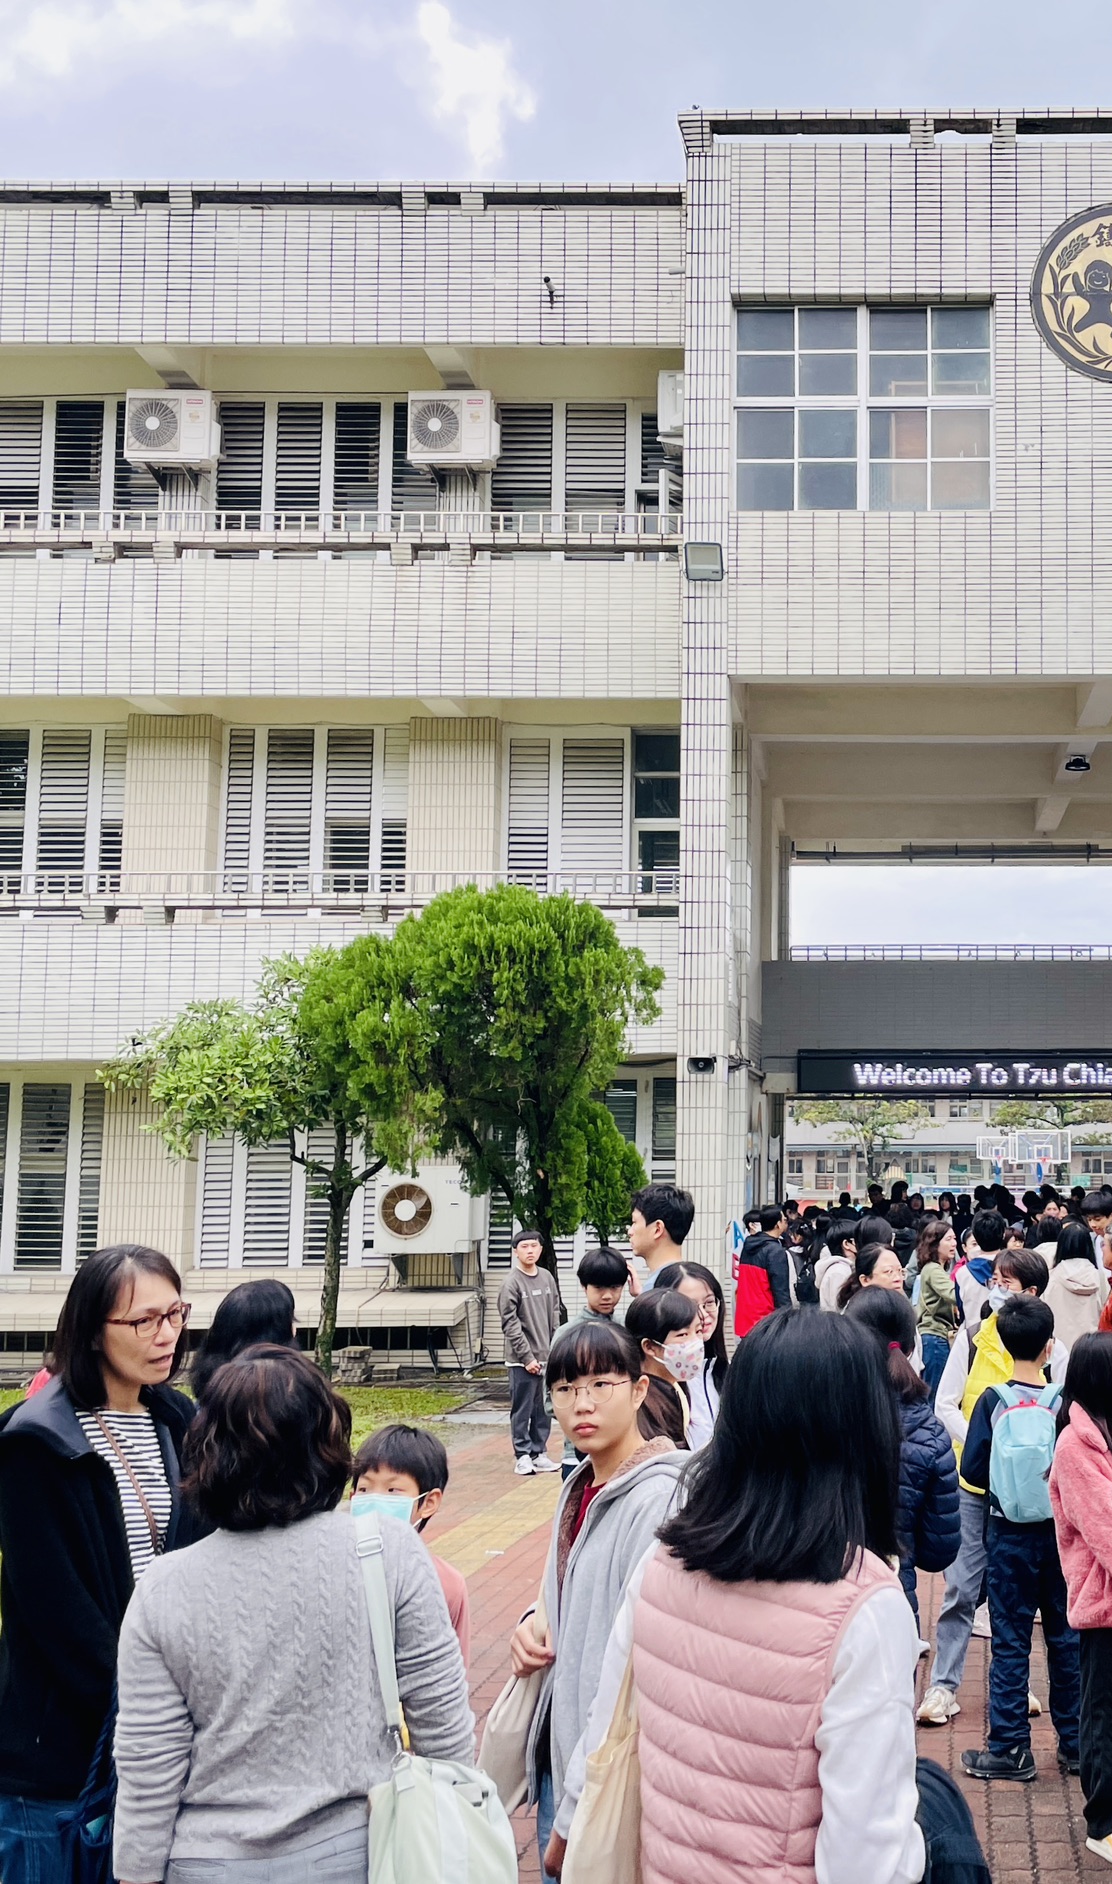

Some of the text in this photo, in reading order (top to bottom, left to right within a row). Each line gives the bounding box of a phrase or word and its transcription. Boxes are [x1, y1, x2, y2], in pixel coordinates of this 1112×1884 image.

[853, 1063, 972, 1085] Welcome
[976, 1063, 1008, 1085] To
[1013, 1063, 1057, 1085] Tzu
